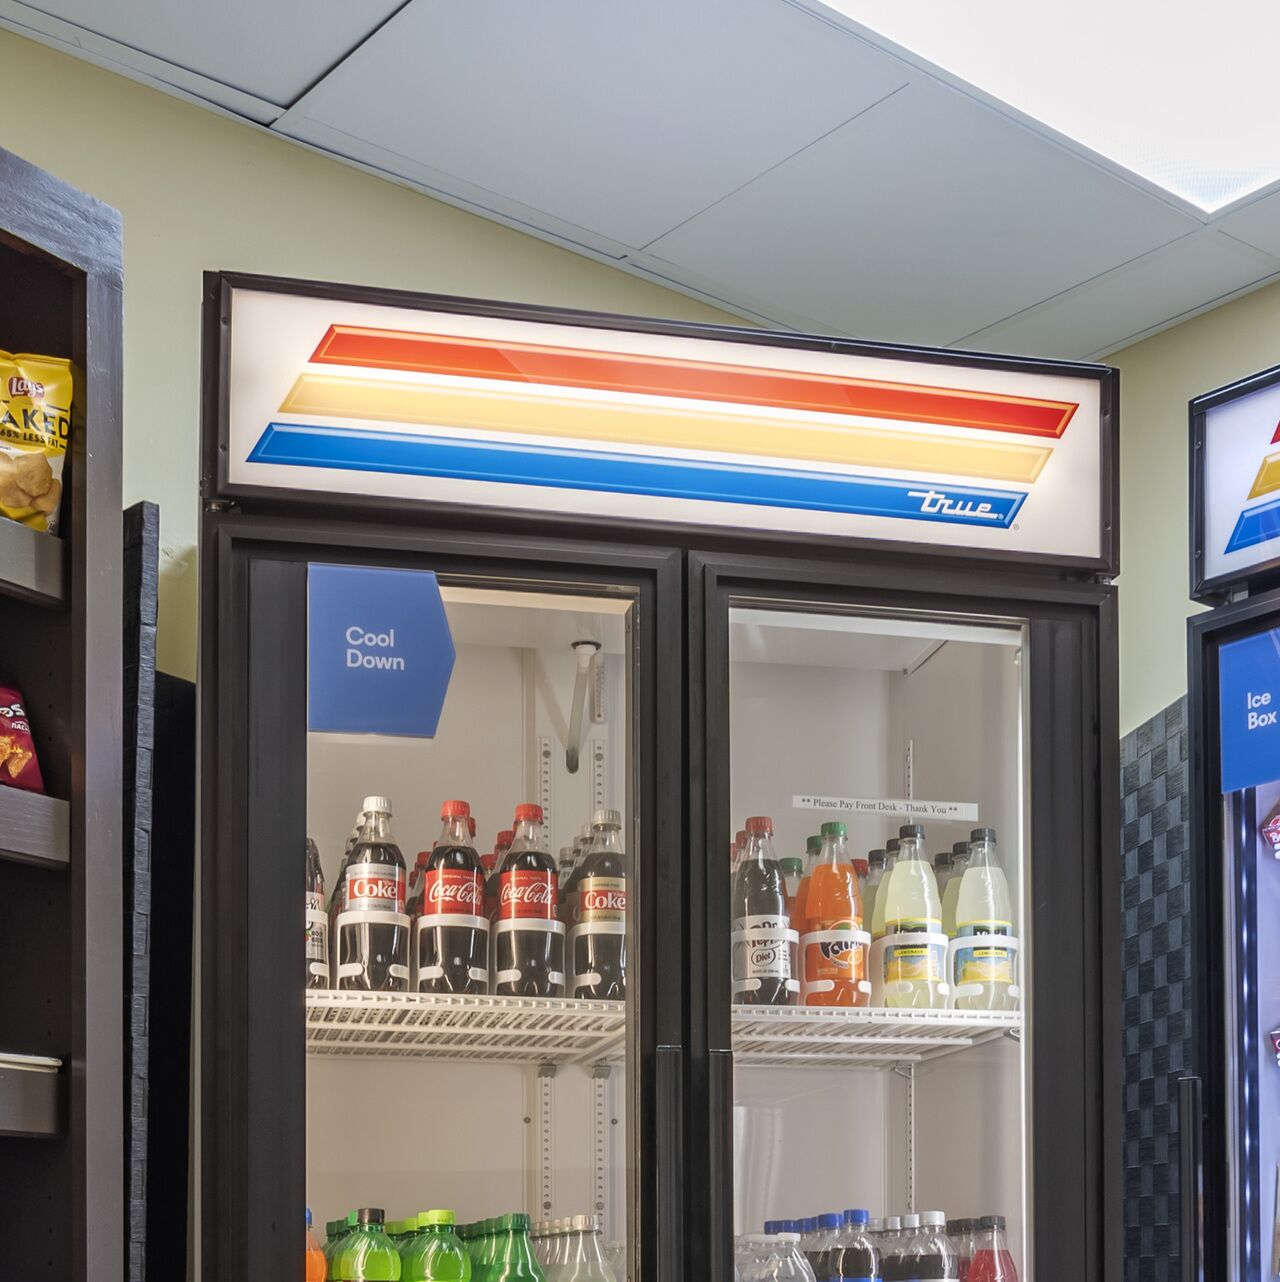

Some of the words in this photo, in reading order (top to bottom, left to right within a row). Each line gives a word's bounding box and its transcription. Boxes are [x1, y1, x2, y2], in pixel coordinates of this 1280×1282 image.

[0, 428, 20, 439] 65%
[23, 431, 46, 443] LESS
[907, 490, 998, 519] true
[345, 626, 394, 648] Cool
[346, 648, 405, 671] Down
[1246, 690, 1271, 709] Ice
[1247, 709, 1277, 731] Box
[813, 799, 837, 808] Please
[839, 800, 853, 810] Pay
[856, 801, 876, 810] Front
[878, 802, 897, 811] Desk
[905, 804, 928, 813] Thank
[930, 804, 947, 814] You
[353, 879, 397, 897] Coke
[428, 880, 482, 905] Coca-Cola
[500, 882, 554, 904] Coca-Cola
[585, 892, 626, 910] Coke
[755, 952, 772, 963] Diet
